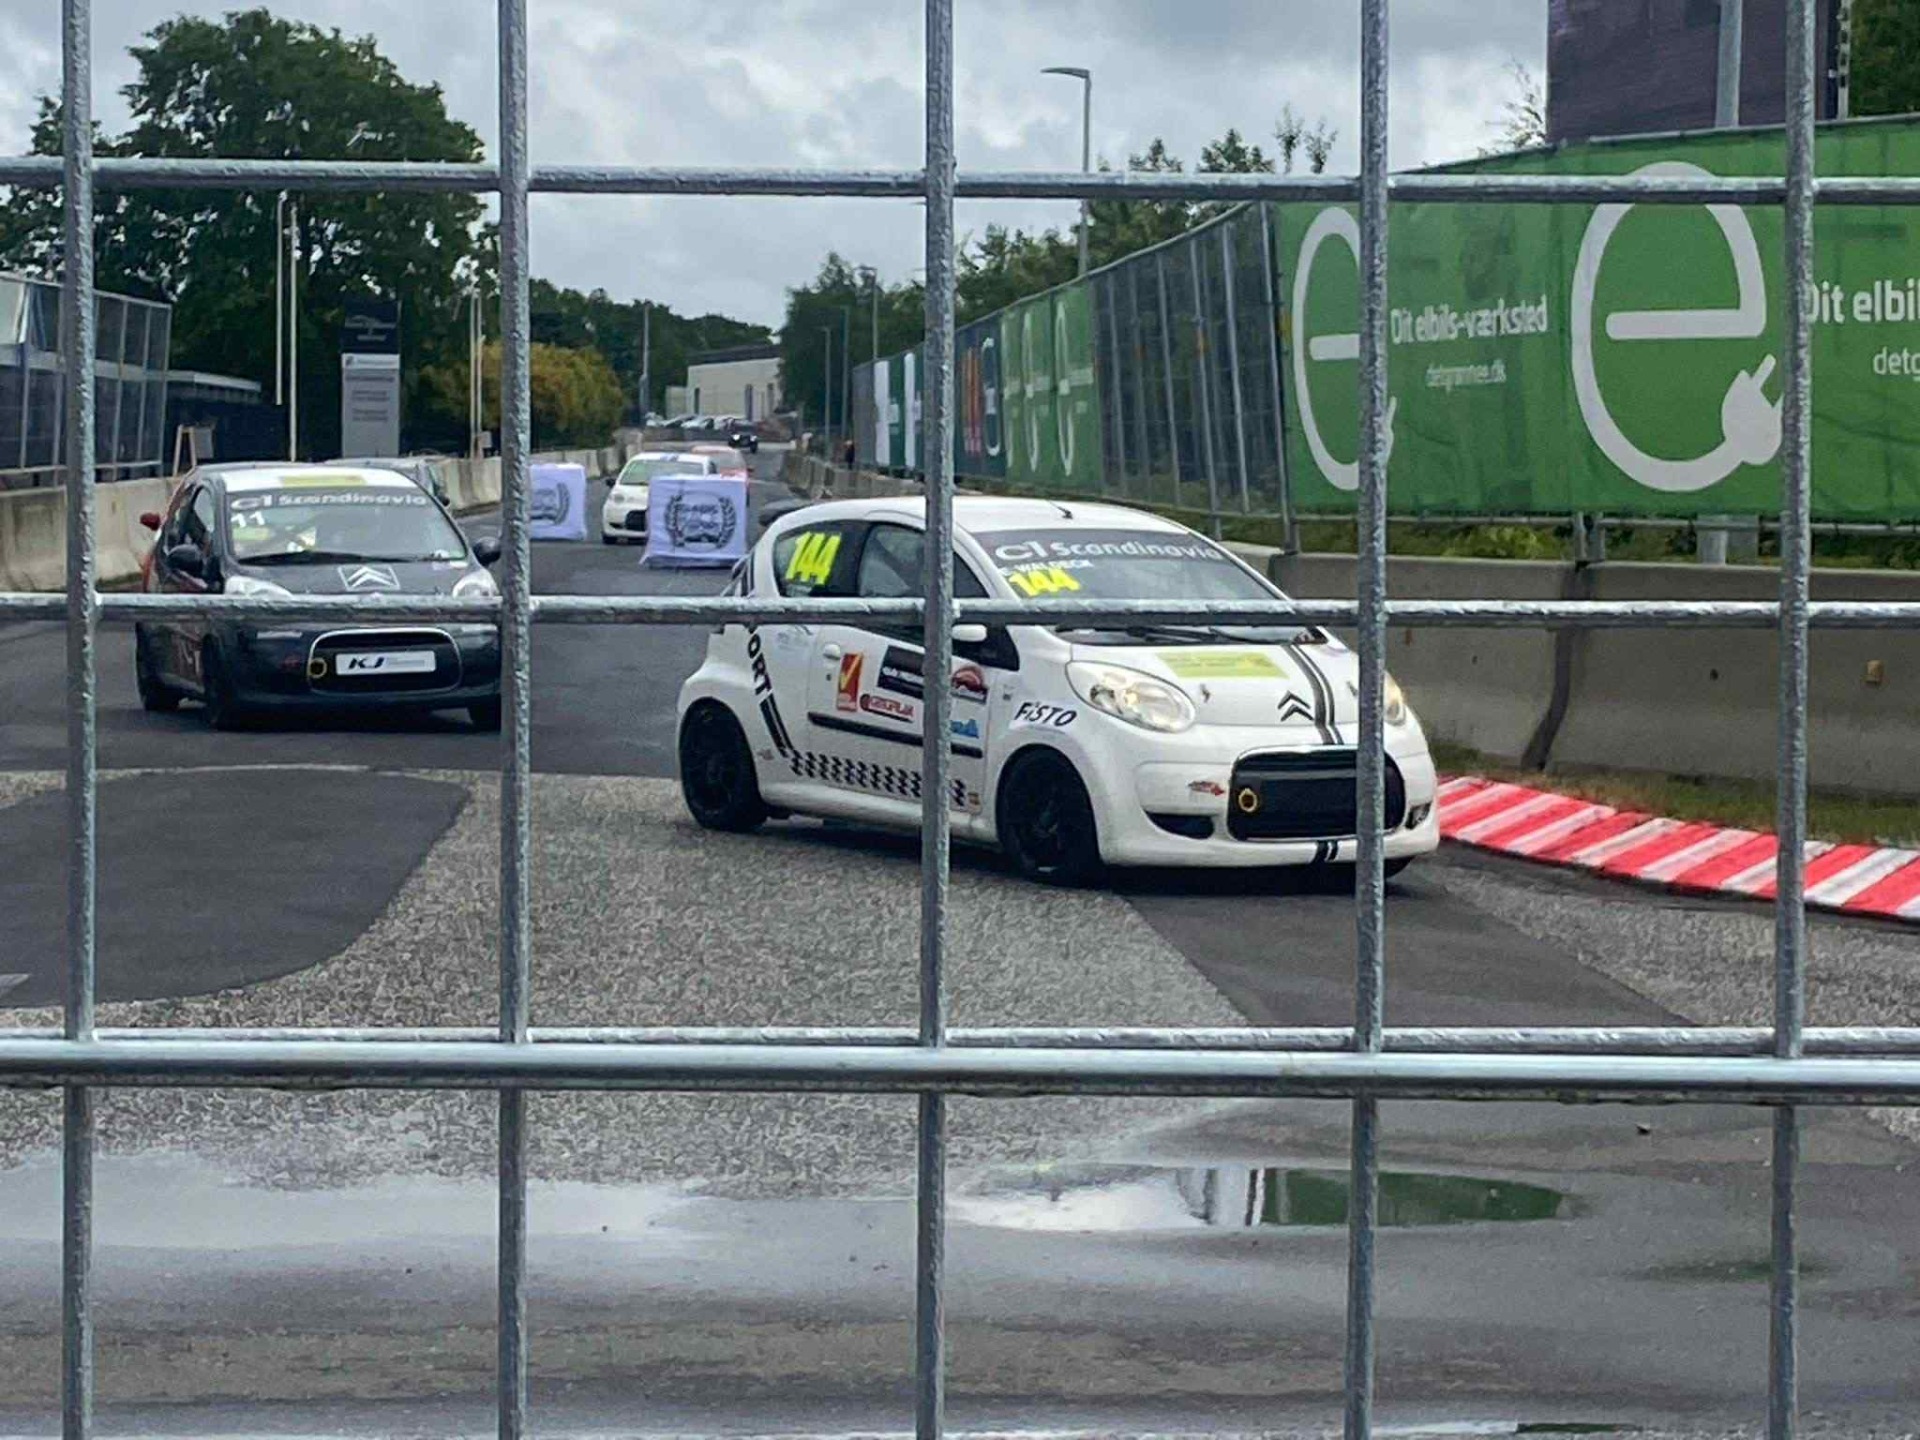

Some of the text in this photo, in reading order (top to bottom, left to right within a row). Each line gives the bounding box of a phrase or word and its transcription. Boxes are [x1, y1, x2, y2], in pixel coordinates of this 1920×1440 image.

[1391, 306, 1414, 344] Dit
[279, 493, 427, 507] Scandinavia
[231, 511, 265, 528] 11
[784, 531, 842, 585] 144
[1050, 540, 1223, 561] Scandinavia
[1008, 567, 1082, 597] 144
